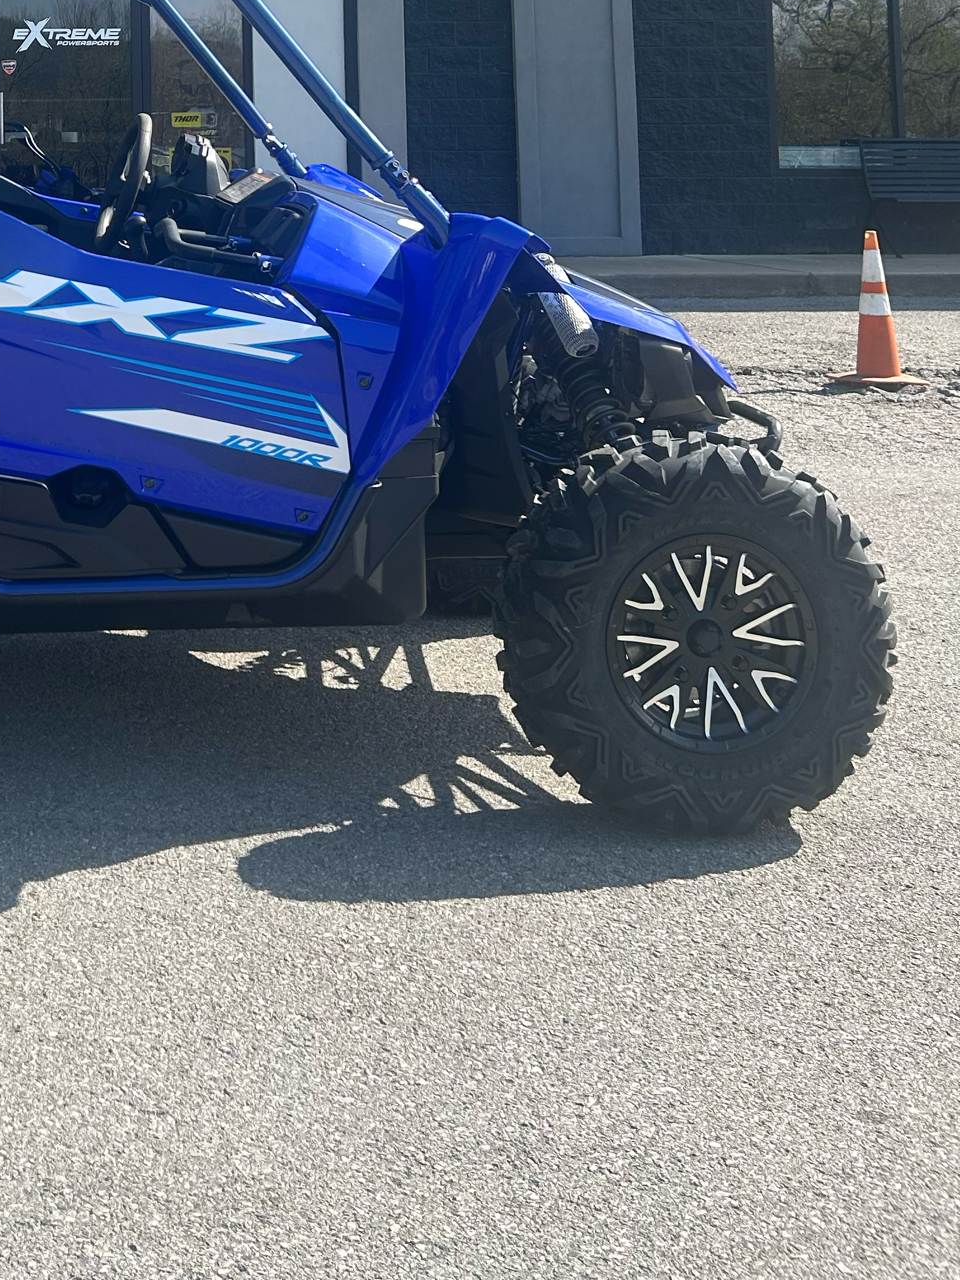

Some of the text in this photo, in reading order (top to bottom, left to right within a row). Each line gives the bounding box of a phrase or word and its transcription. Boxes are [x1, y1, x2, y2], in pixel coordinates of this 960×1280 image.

[12, 17, 121, 53] EXTREME
[173, 115, 200, 123] THOR
[220, 435, 333, 468] 1000R
